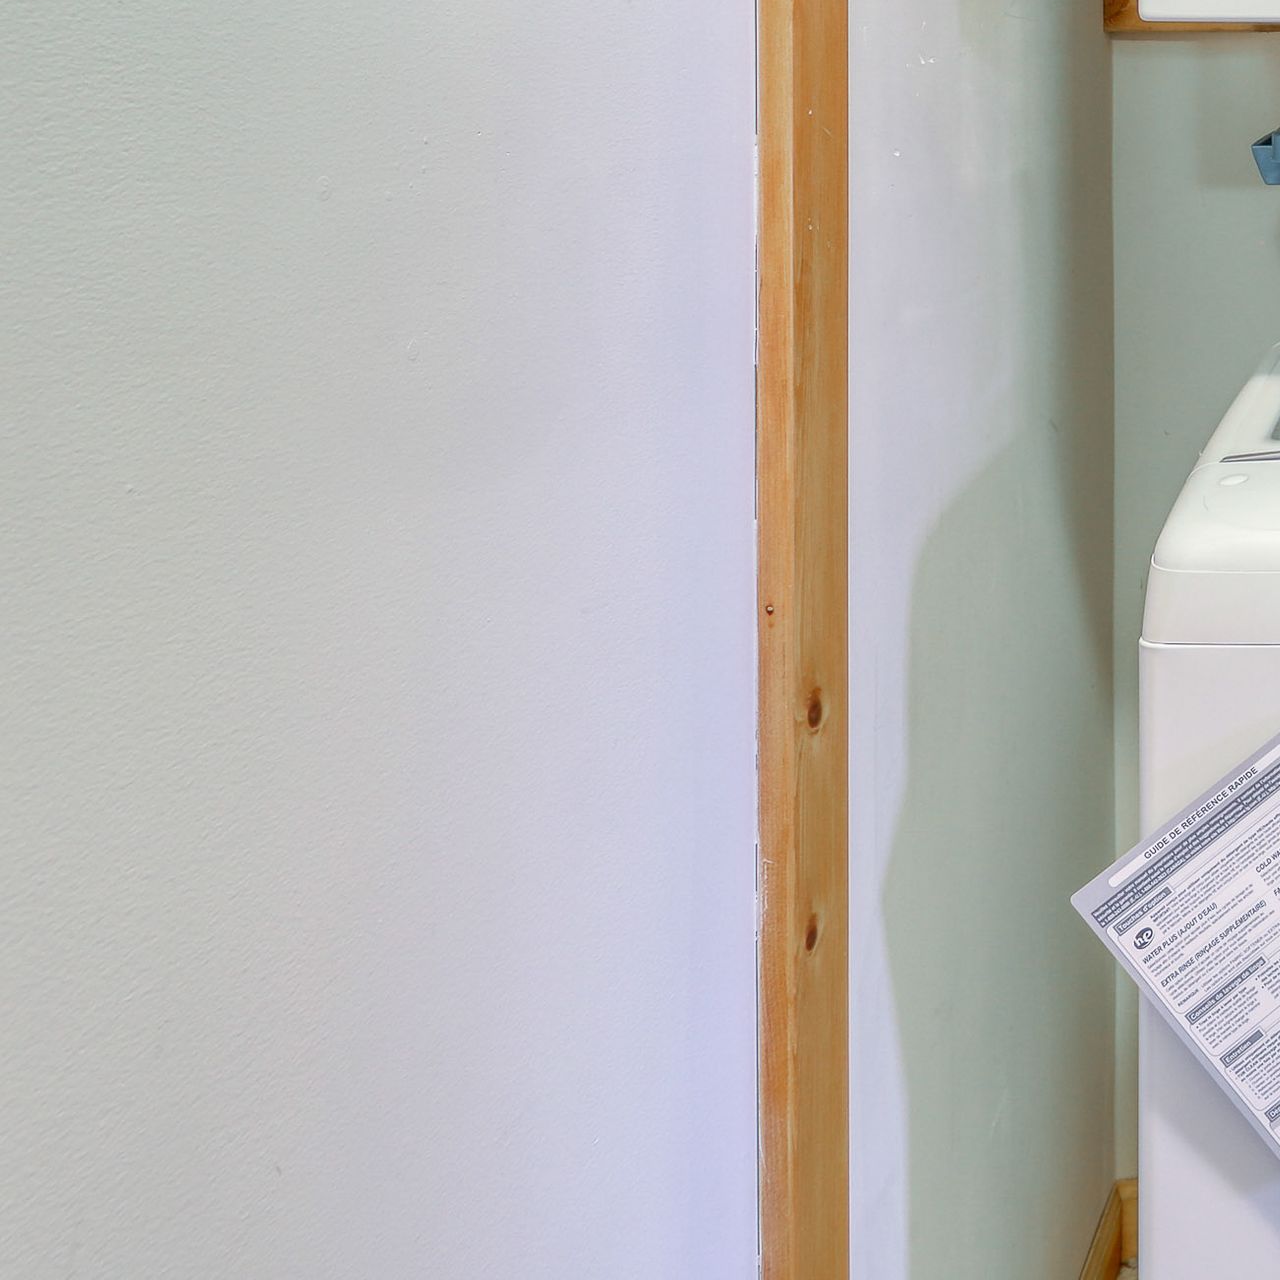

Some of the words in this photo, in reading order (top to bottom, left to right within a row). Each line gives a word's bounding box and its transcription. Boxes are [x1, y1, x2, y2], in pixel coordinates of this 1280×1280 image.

[1142, 836, 1170, 860] GUIDE
[1167, 826, 1183, 840] DE
[1178, 788, 1230, 830] RÉFÉRENCE
[1226, 765, 1259, 793] RAPIDE
[1254, 856, 1273, 873] COLD
[1140, 944, 1164, 964] WATER
[1160, 932, 1179, 949] PLUS
[1159, 969, 1180, 987] EXTRA
[1176, 956, 1196, 973] RINSE
[1224, 1039, 1252, 1064] Entretien
